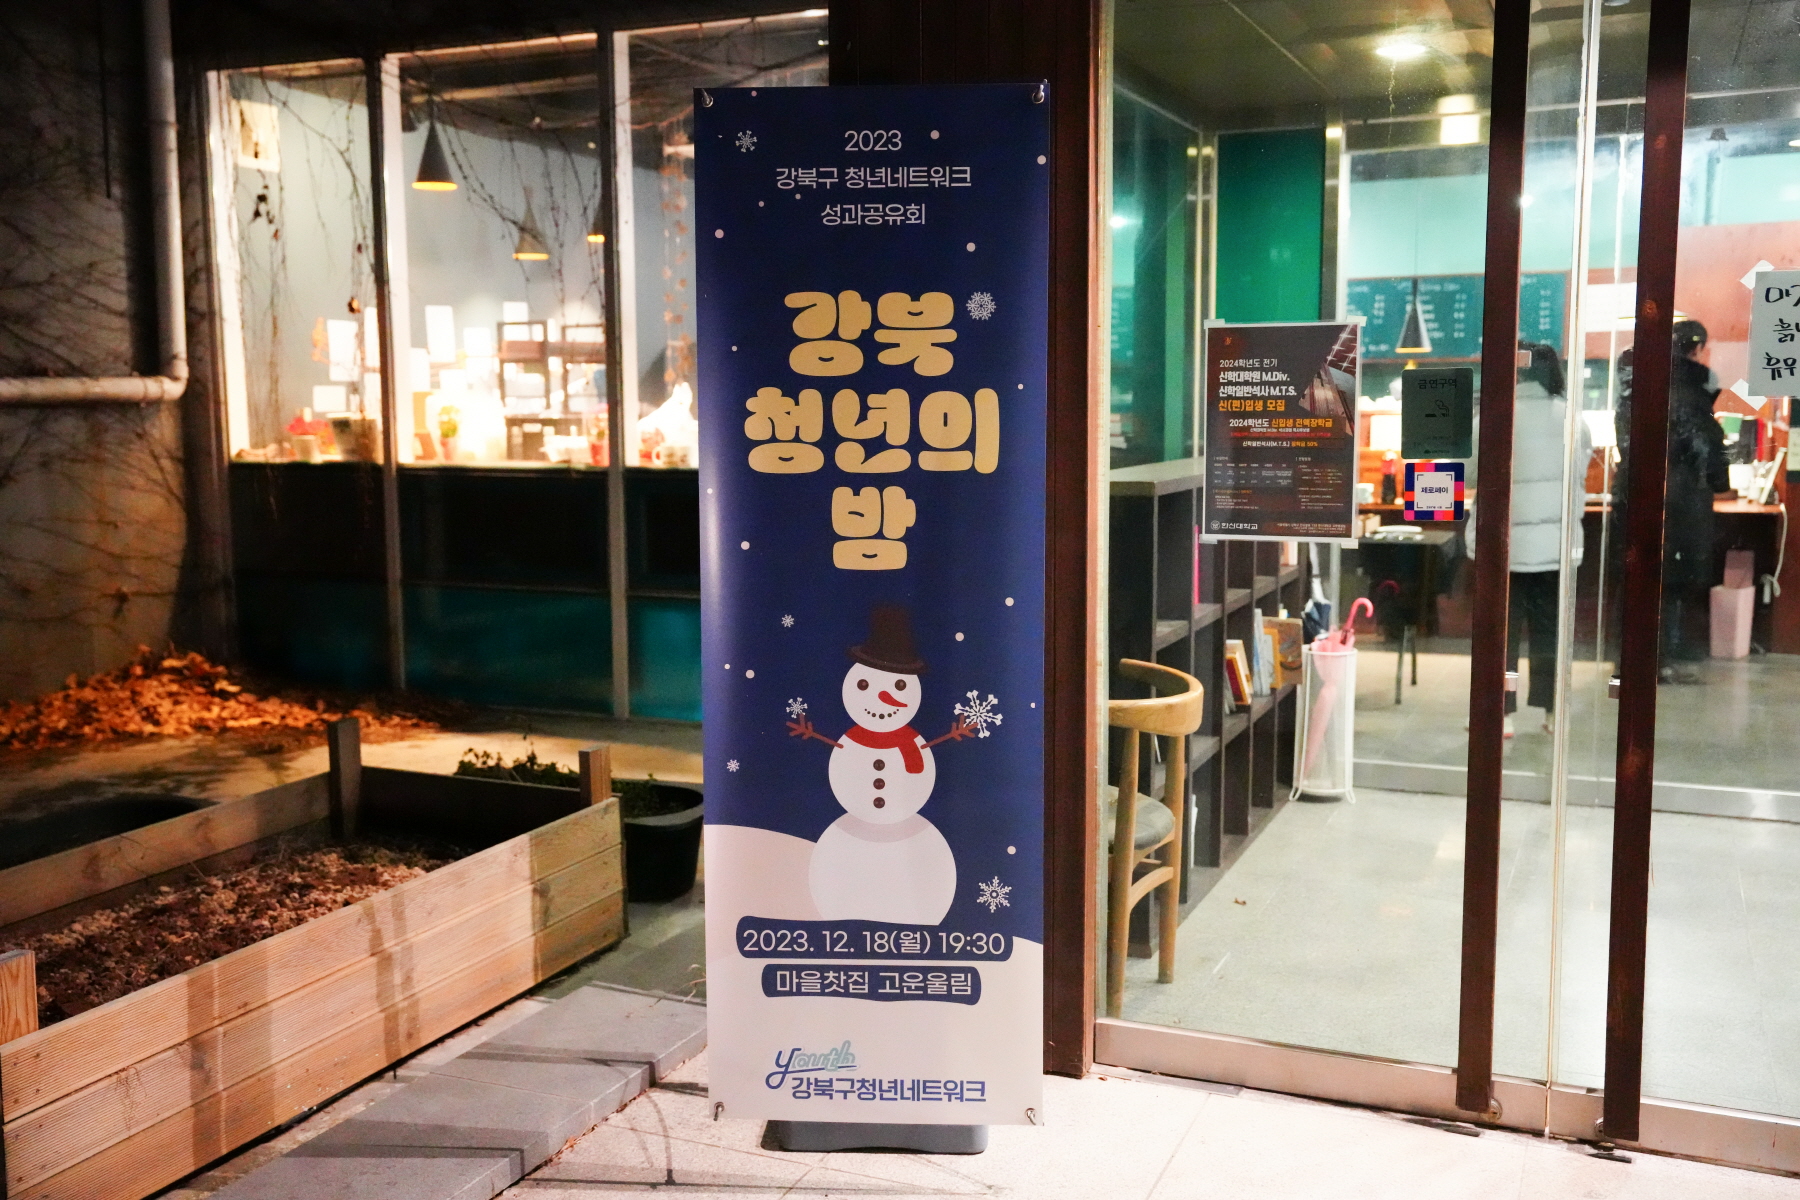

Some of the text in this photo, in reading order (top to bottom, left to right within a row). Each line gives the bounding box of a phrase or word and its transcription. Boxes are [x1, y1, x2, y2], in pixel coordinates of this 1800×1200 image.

[844, 130, 903, 151] 2023
[776, 166, 972, 189] 강북구 청년네트워크
[821, 203, 926, 226] 성과공유회
[1765, 284, 1800, 307] 마
[784, 290, 958, 377] 강북
[1219, 358, 1278, 368] 2024학년도 전기
[1219, 371, 1290, 383] 신학대학원 M.Div.
[1418, 378, 1458, 390] 금연구역
[1219, 386, 1297, 397] 신학일반석사 M.T.S.
[1218, 400, 1285, 412] 신(편)입생 모집
[744, 386, 1000, 474] 청년의
[1229, 419, 1269, 427] 2024학년도
[1421, 486, 1448, 494] 제로페이
[831, 486, 917, 570] 밤
[1221, 522, 1258, 530] 한신대학교
[742, 930, 1005, 954] 2023. 12. 18(월) 19:30
[776, 970, 972, 995] 마을찻집 고운울림
[791, 1077, 987, 1102] 강북구청년네트워크
